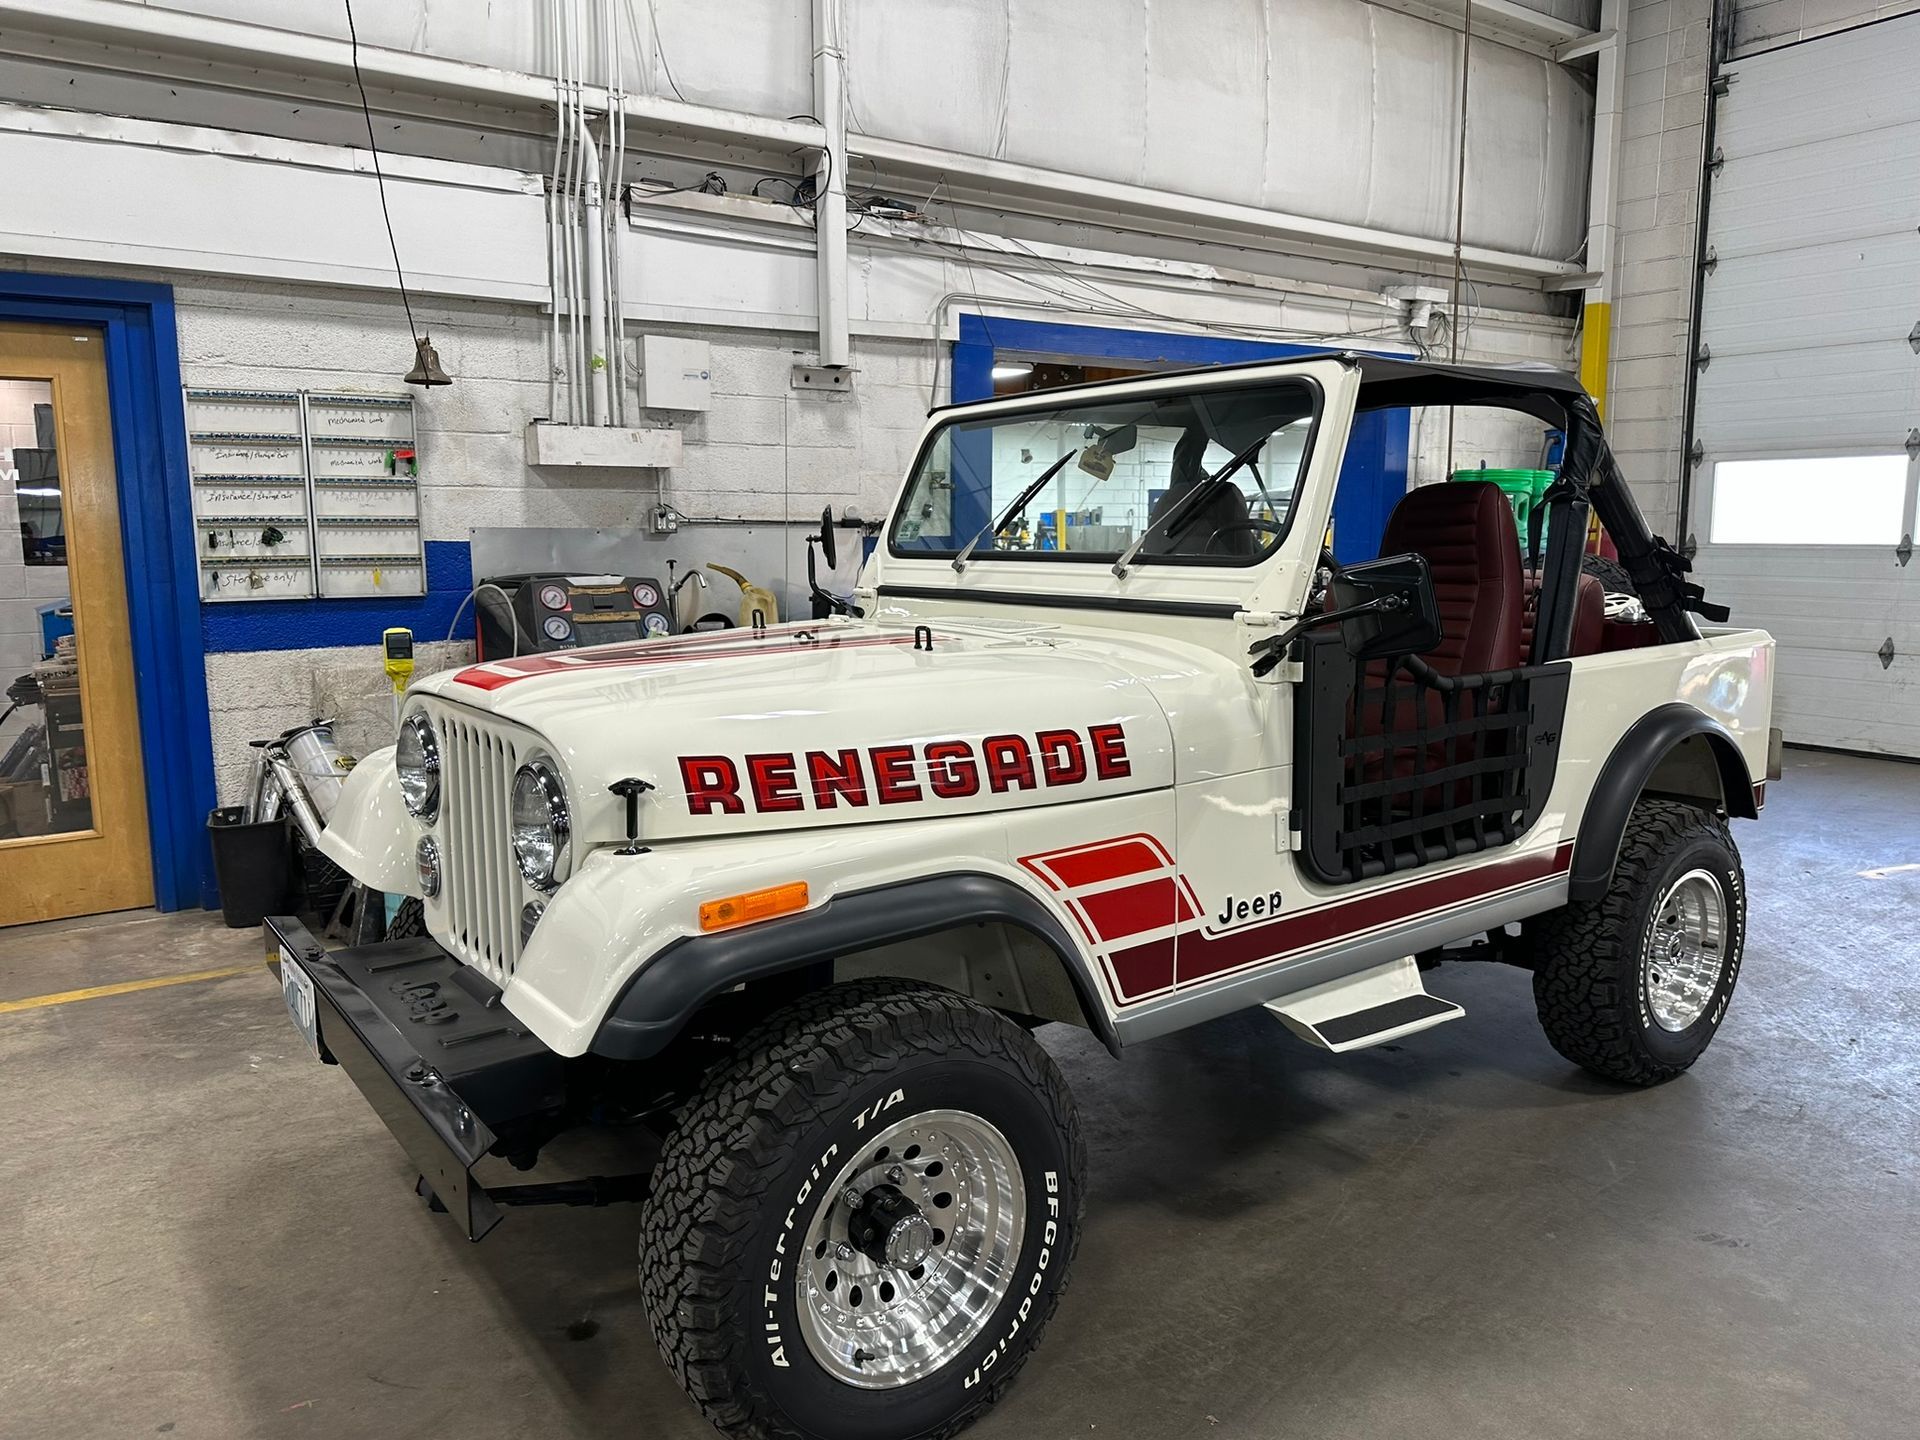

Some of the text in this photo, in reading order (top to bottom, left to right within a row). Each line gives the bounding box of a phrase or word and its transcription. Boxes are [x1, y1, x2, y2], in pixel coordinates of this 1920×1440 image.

[678, 723, 1131, 815] RENEGADE
[1218, 891, 1282, 924] Jeep
[389, 981, 460, 1025] Jeep
[764, 1088, 905, 1369] All-Terrain T/A
[963, 1170, 1057, 1390] BFGoodrich
